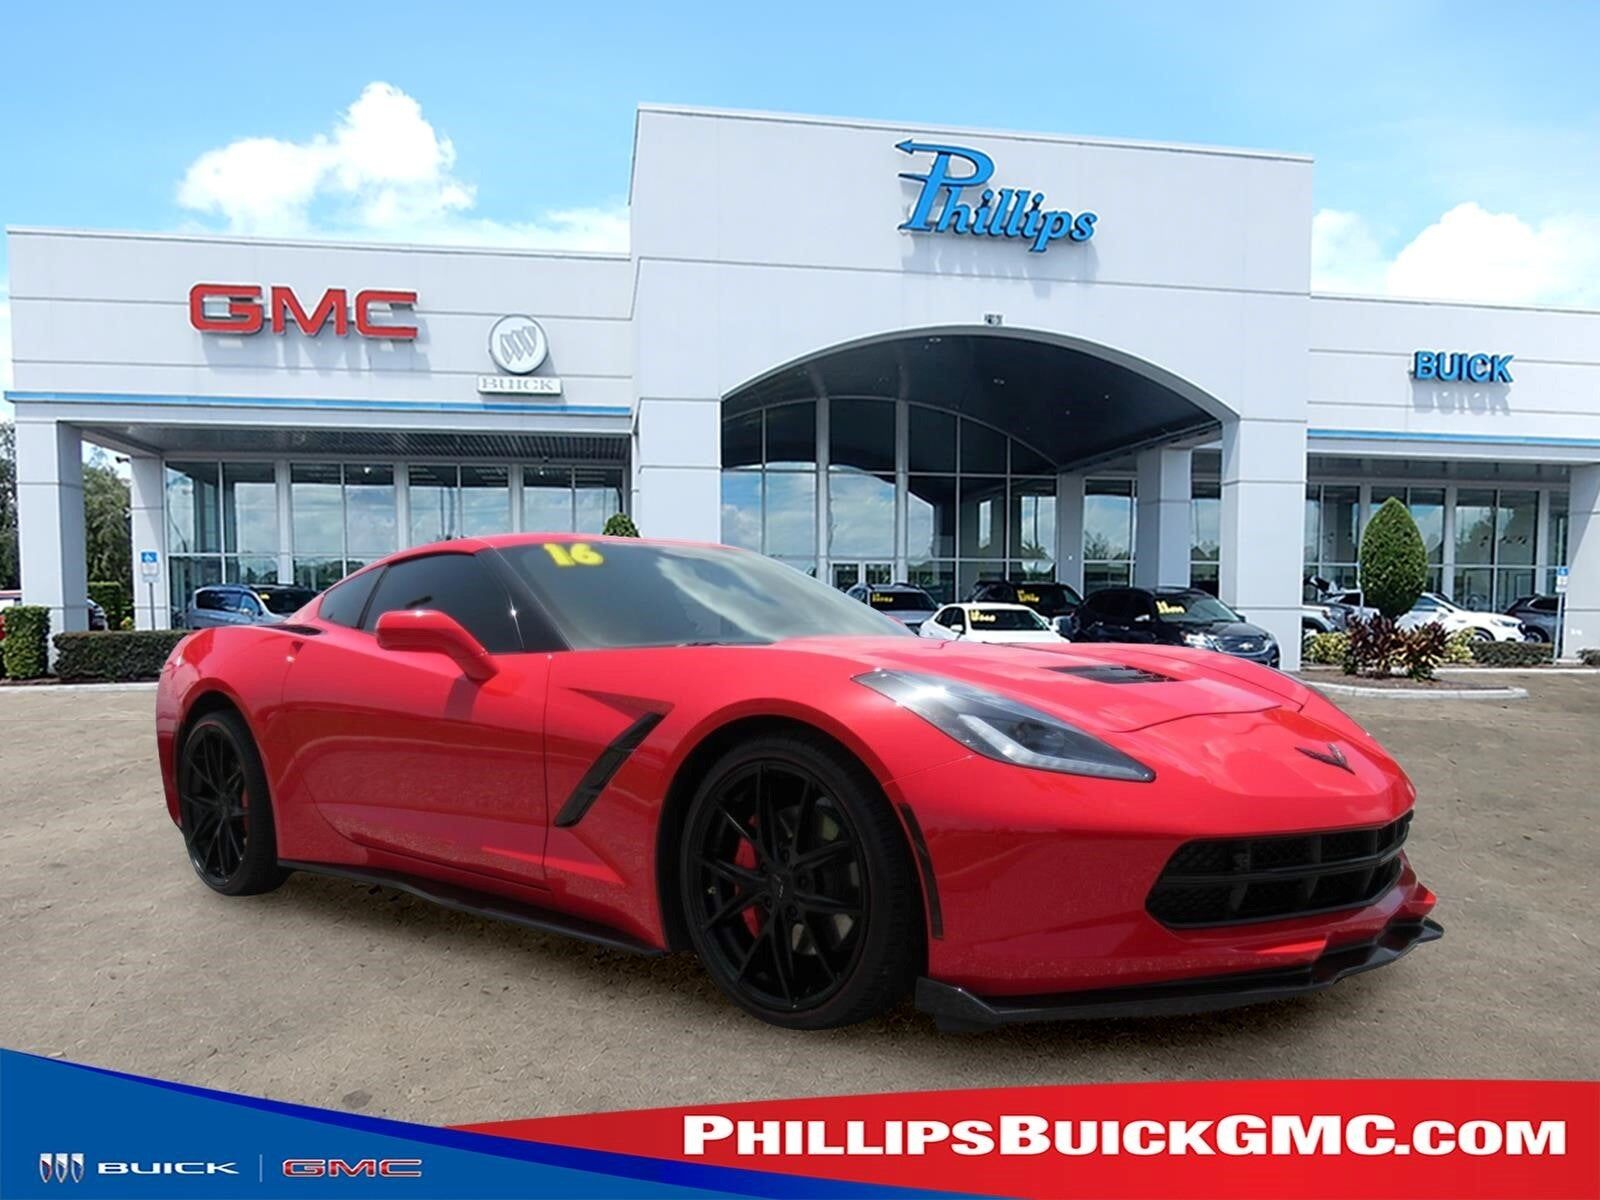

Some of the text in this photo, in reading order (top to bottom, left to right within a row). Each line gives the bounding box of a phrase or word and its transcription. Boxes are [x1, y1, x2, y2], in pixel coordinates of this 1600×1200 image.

[894, 139, 1098, 253] Phillips
[189, 283, 418, 340] GMC
[1413, 350, 1514, 383] BUICK
[481, 377, 555, 392] BUICK
[542, 542, 604, 567] 16
